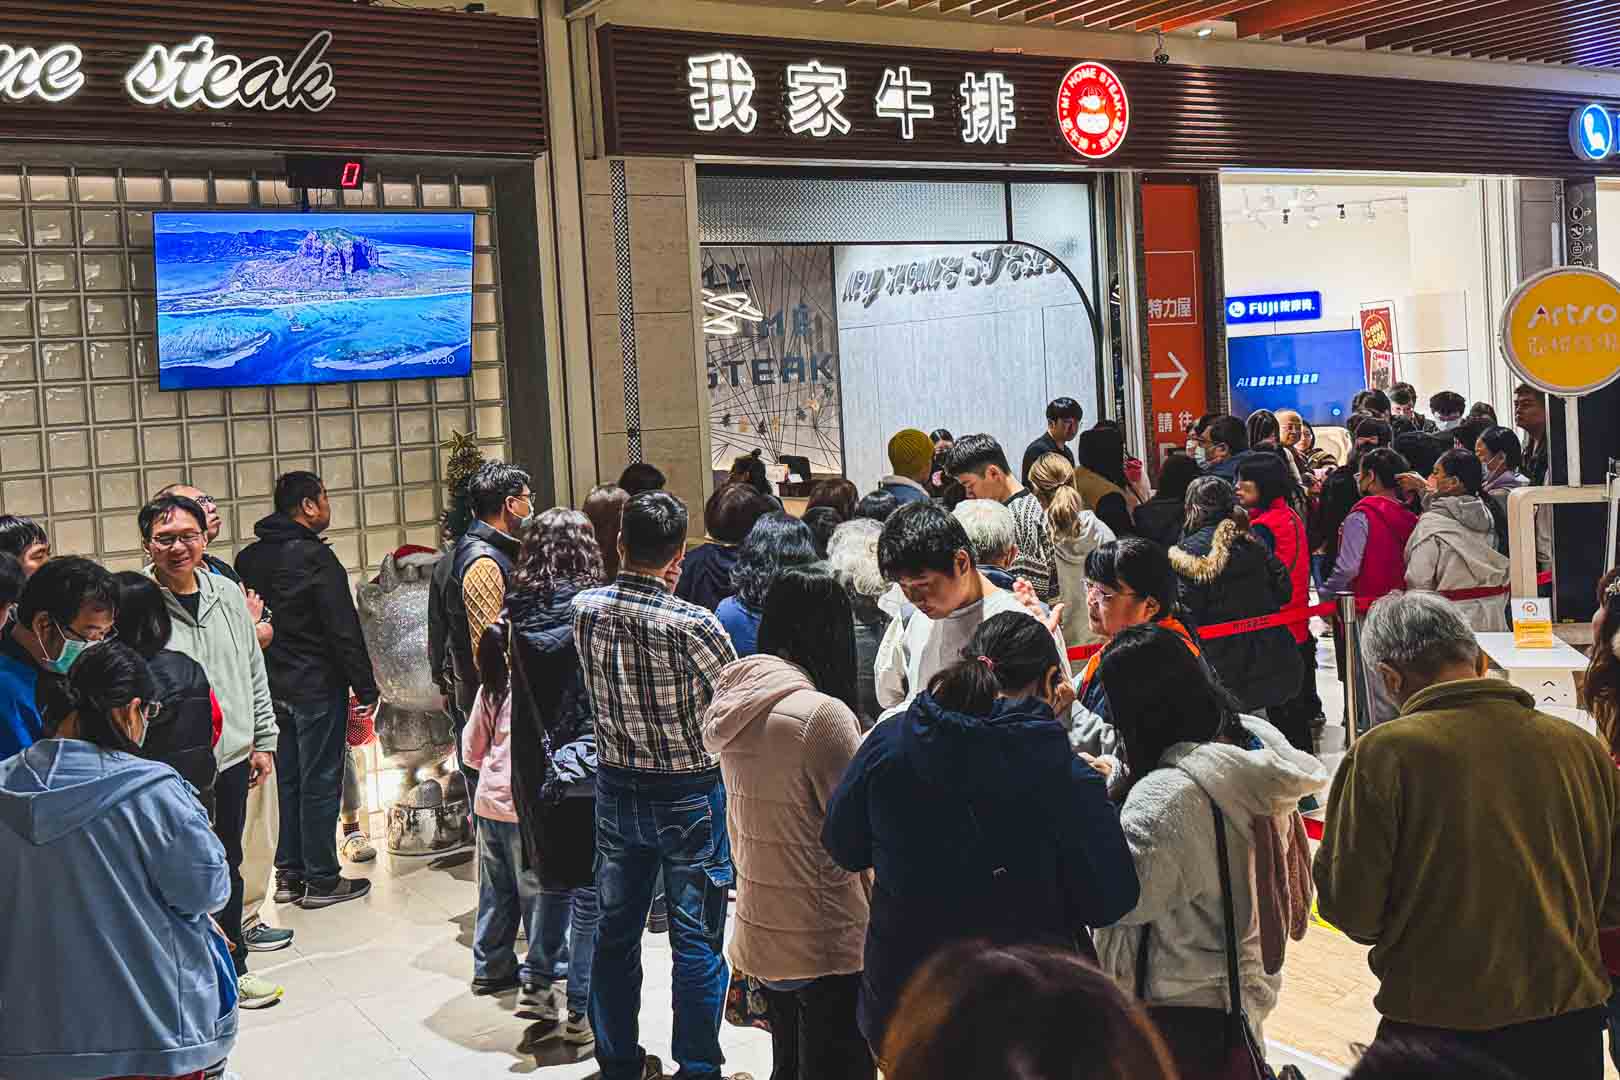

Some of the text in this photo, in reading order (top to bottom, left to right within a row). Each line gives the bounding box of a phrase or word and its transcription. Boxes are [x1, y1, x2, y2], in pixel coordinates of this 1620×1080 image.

[127, 31, 336, 112] steak
[1061, 67, 1123, 112] MY HOME STEAK
[687, 53, 1017, 144] 我家牛排
[341, 163, 360, 186] 0
[1148, 297, 1192, 319] 特力屋
